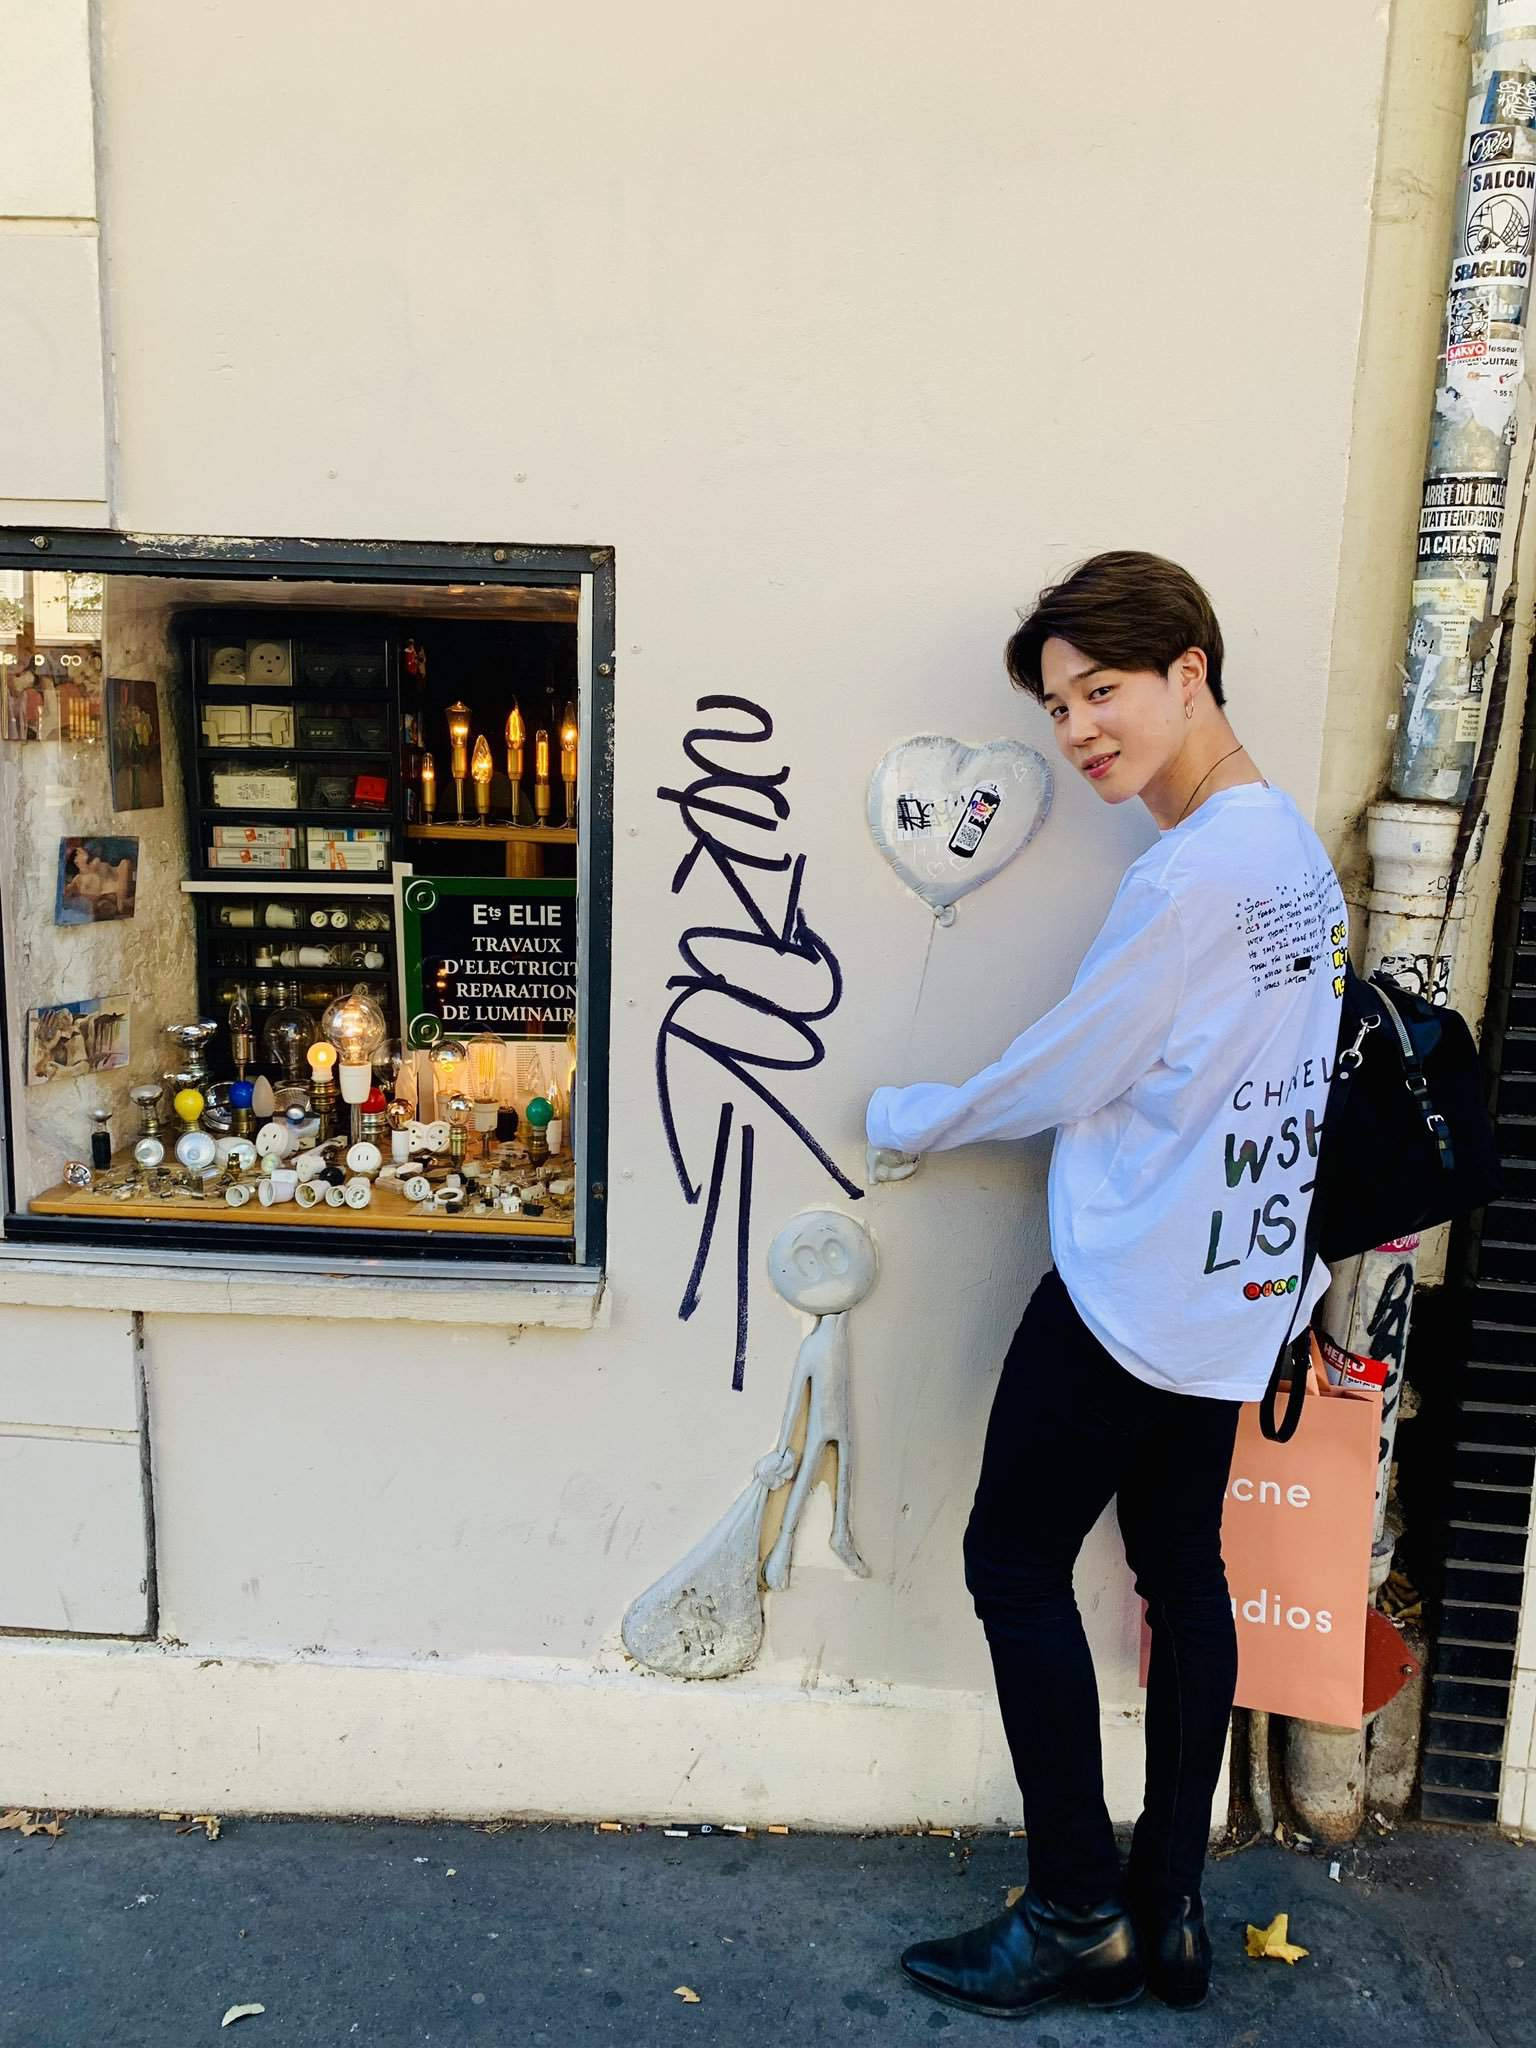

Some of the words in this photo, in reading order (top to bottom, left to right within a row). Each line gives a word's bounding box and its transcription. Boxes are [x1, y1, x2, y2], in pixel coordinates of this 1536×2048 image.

[1455, 259, 1526, 282] SBAGLIATO
[1455, 484, 1473, 504] DU
[1422, 510, 1497, 528] N'ATTENDONS
[1419, 537, 1430, 555] LA
[509, 905, 562, 926] ELIE
[472, 937, 562, 953] TRAVAUX
[456, 983, 577, 999] REPARATION
[442, 1005, 470, 1021] DE
[1225, 1478, 1310, 1508] cne
